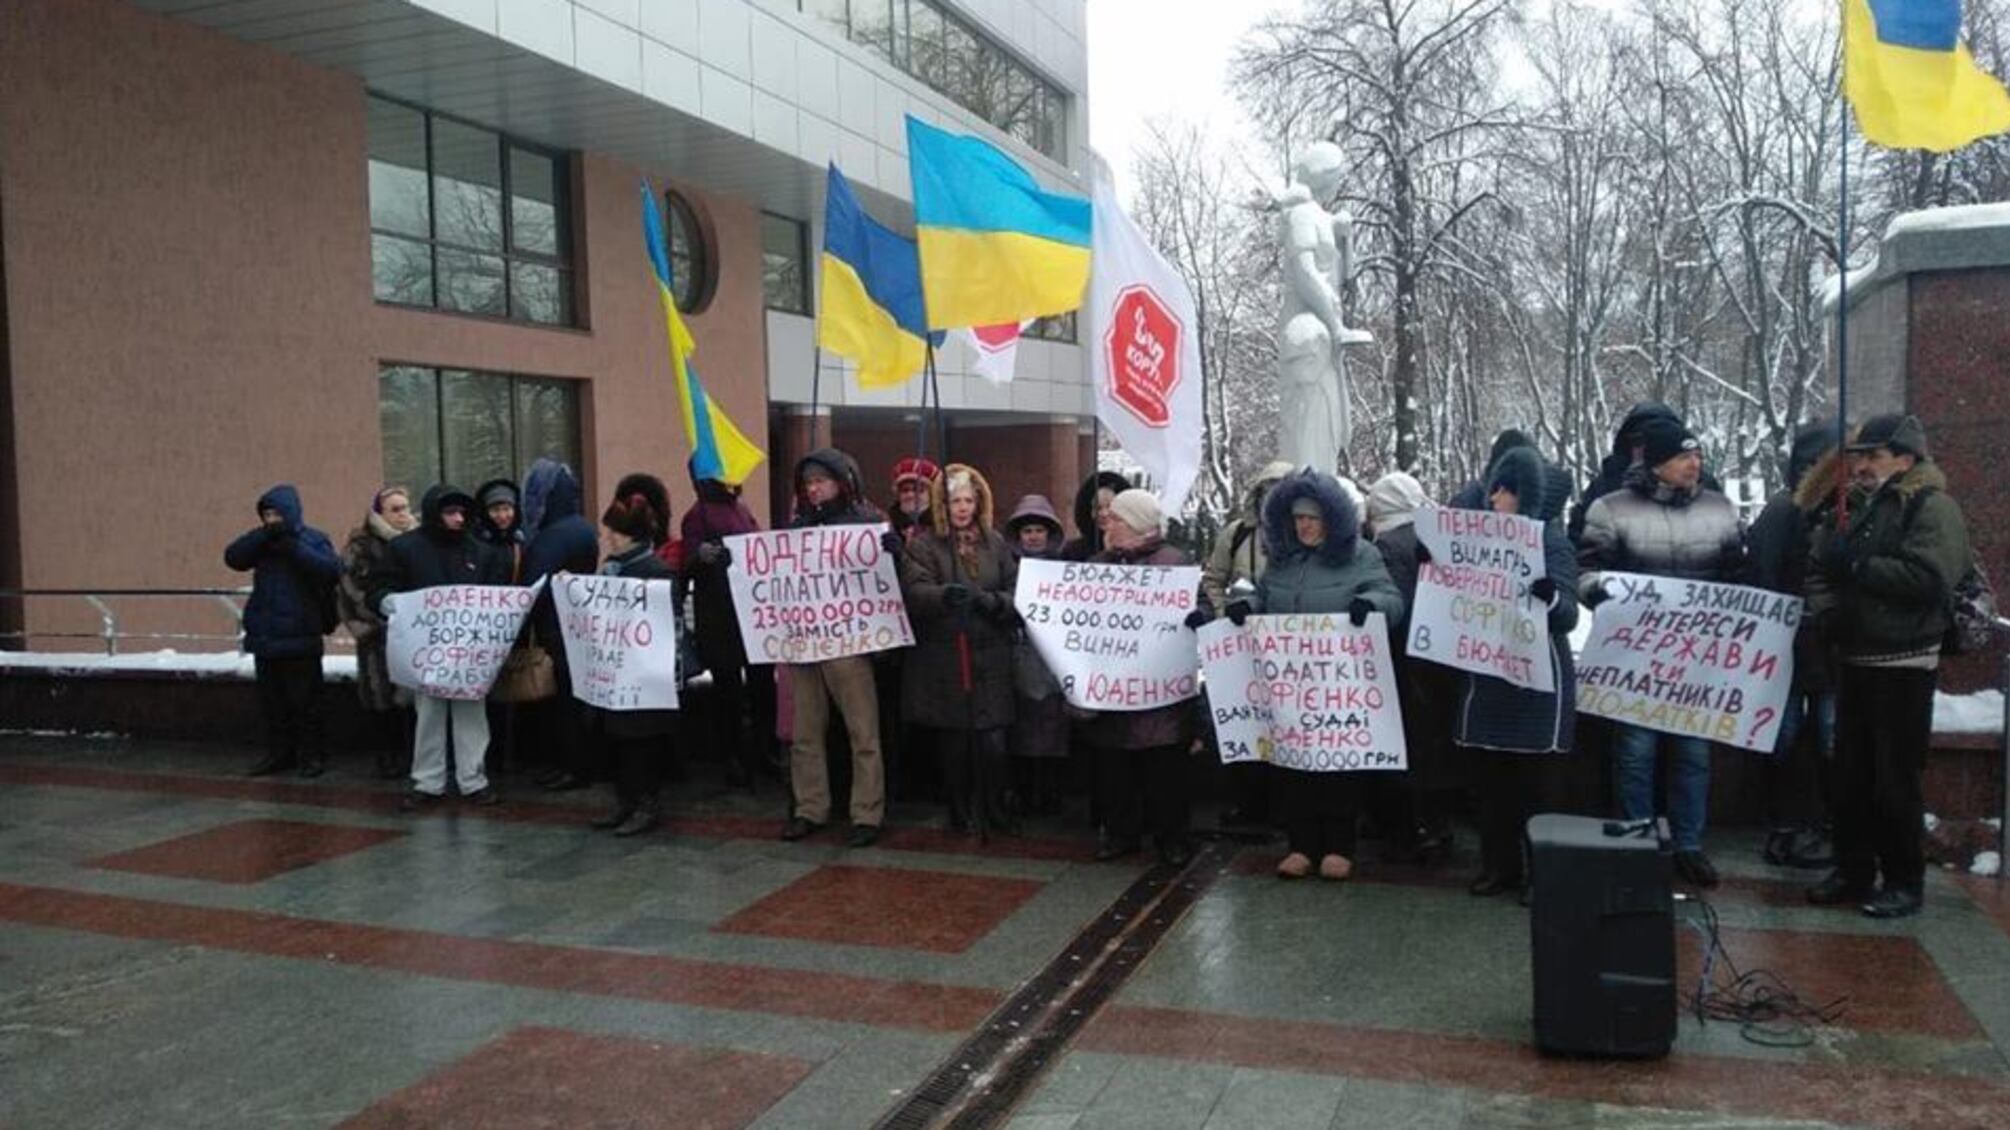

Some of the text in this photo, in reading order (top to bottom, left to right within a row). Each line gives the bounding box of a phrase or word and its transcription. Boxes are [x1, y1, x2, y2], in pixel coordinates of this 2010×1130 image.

[745, 530, 878, 576] ЮДЕНКО
[752, 569, 889, 603] СПЛАТИТЬ
[1062, 563, 1173, 586] БЮДЖЕТ
[424, 588, 533, 609] ЮДЕНКО
[566, 577, 648, 611] СУДДЯ
[1601, 577, 1799, 628] СУД ЗАХИЩАЄ
[787, 618, 868, 639] ЗАМІСТЬ
[1637, 605, 1758, 642] ІНТЕРЕСИ
[1253, 659, 1378, 682] ПОДАТКІВ
[1602, 627, 1778, 682] ДЕРЖАВИ
[1651, 659, 1686, 682] ЧИ
[1086, 672, 1194, 706] ЮДЕНКО
[1246, 681, 1384, 711] СОФІЄНКО
[1574, 666, 1744, 715] НЕПЛАТНИКІВ
[1300, 709, 1370, 730] СУДДІ
[1582, 686, 1738, 740] ПОДАТКІВ
[1223, 741, 1250, 759] ЗА
